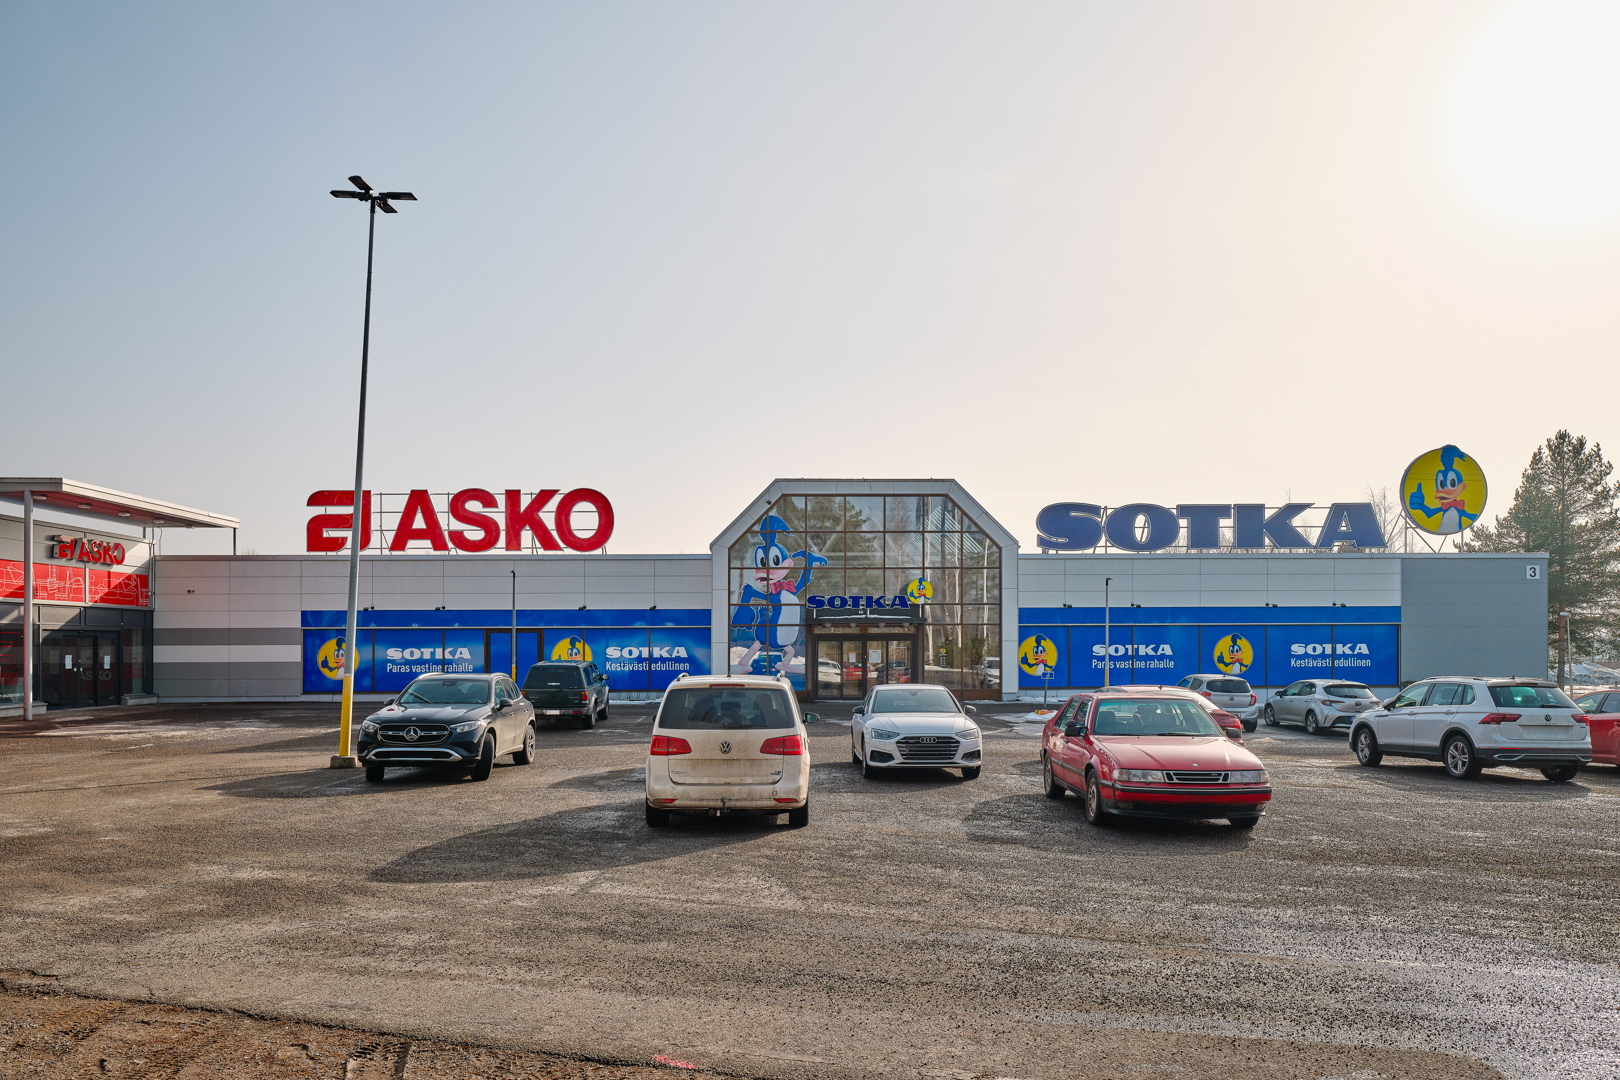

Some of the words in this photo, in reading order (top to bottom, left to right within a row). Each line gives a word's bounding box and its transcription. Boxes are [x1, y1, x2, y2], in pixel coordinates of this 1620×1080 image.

[389, 488, 615, 553] ASKO
[1036, 502, 1388, 552] SOTKA
[77, 537, 126, 565] ASKO
[1529, 566, 1537, 578] 3
[807, 595, 910, 610] SOTKA
[386, 647, 471, 660] SOTKA
[605, 646, 688, 658] SOTKA
[1092, 644, 1173, 656] SOTKA
[1290, 643, 1370, 655] SOTKA
[387, 663, 410, 673] Paras
[411, 662, 442, 673] vastine
[445, 662, 473, 672] rahalle
[605, 661, 649, 671] Kestävästi
[651, 660, 690, 671] edullinen
[1092, 659, 1114, 669] Pars
[1115, 659, 1145, 669] vastine
[1147, 659, 1174, 668] rahalle
[1290, 658, 1332, 667] Kestävästi
[1334, 657, 1371, 667] edullinen
